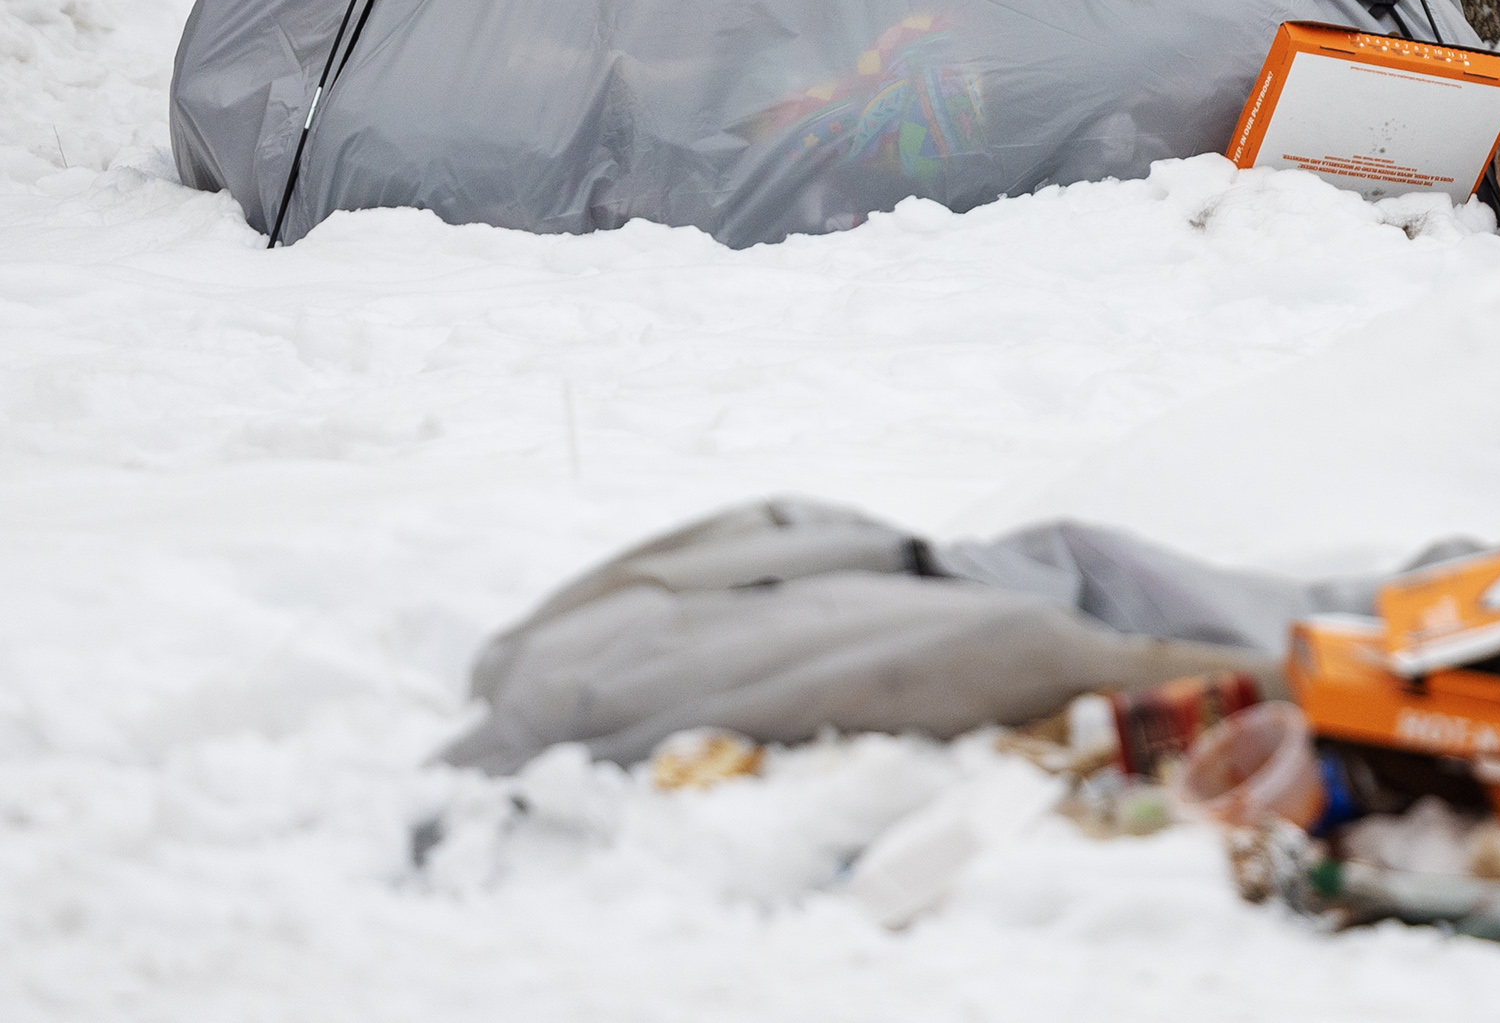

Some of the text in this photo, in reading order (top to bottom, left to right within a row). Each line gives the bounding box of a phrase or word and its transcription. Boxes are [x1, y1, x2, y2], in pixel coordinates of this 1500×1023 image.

[1240, 136, 1246, 146] IN
[1244, 117, 1254, 135] OUR
[1252, 71, 1273, 118] PLAYBOOK!
